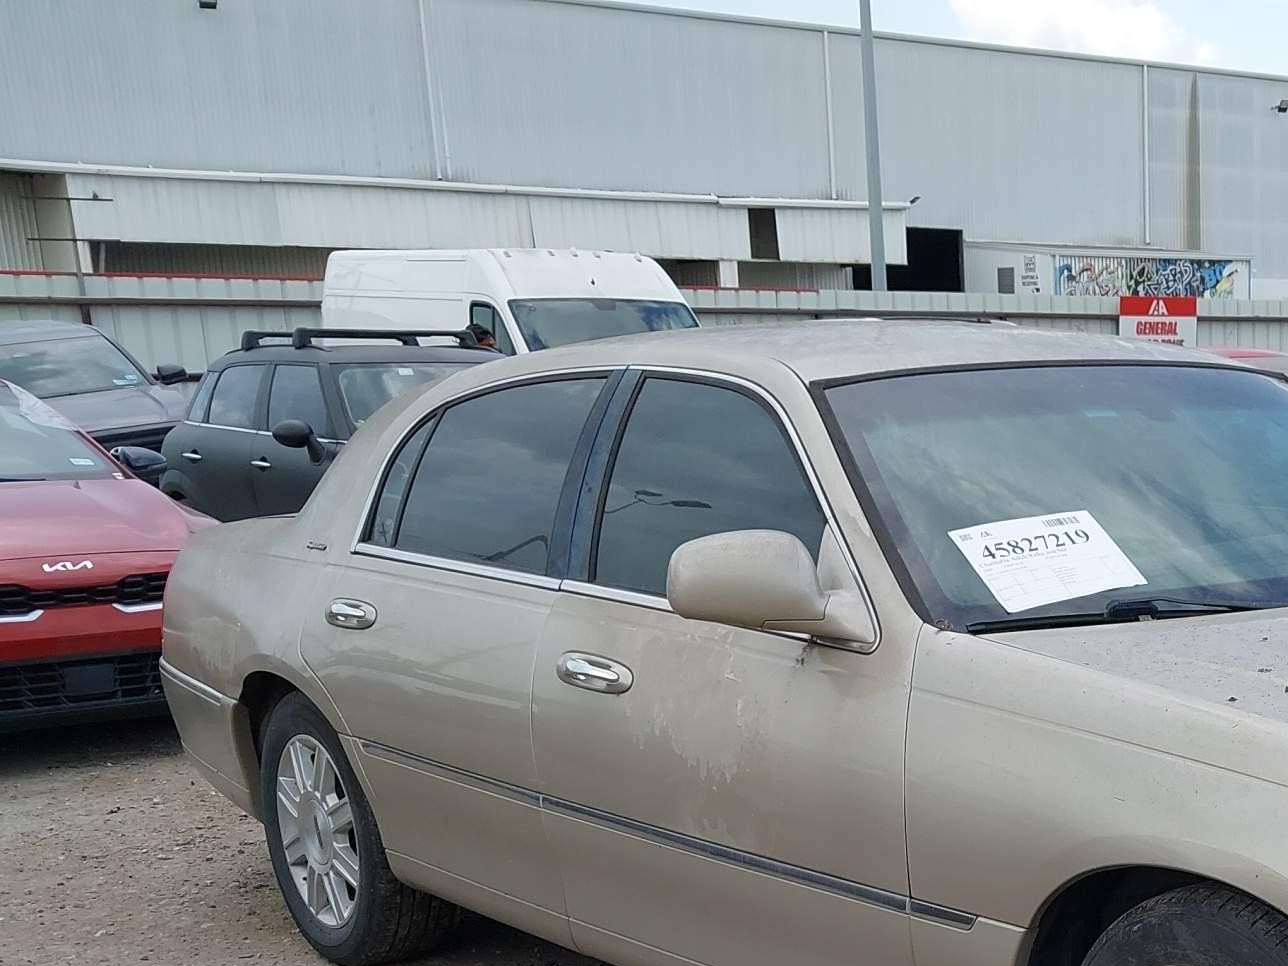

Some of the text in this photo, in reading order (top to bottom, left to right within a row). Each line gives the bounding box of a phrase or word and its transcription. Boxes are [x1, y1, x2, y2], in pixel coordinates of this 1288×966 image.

[1136, 321, 1178, 336] GENERAL
[982, 529, 1090, 559] 45827219
[42, 559, 94, 573] KIA
